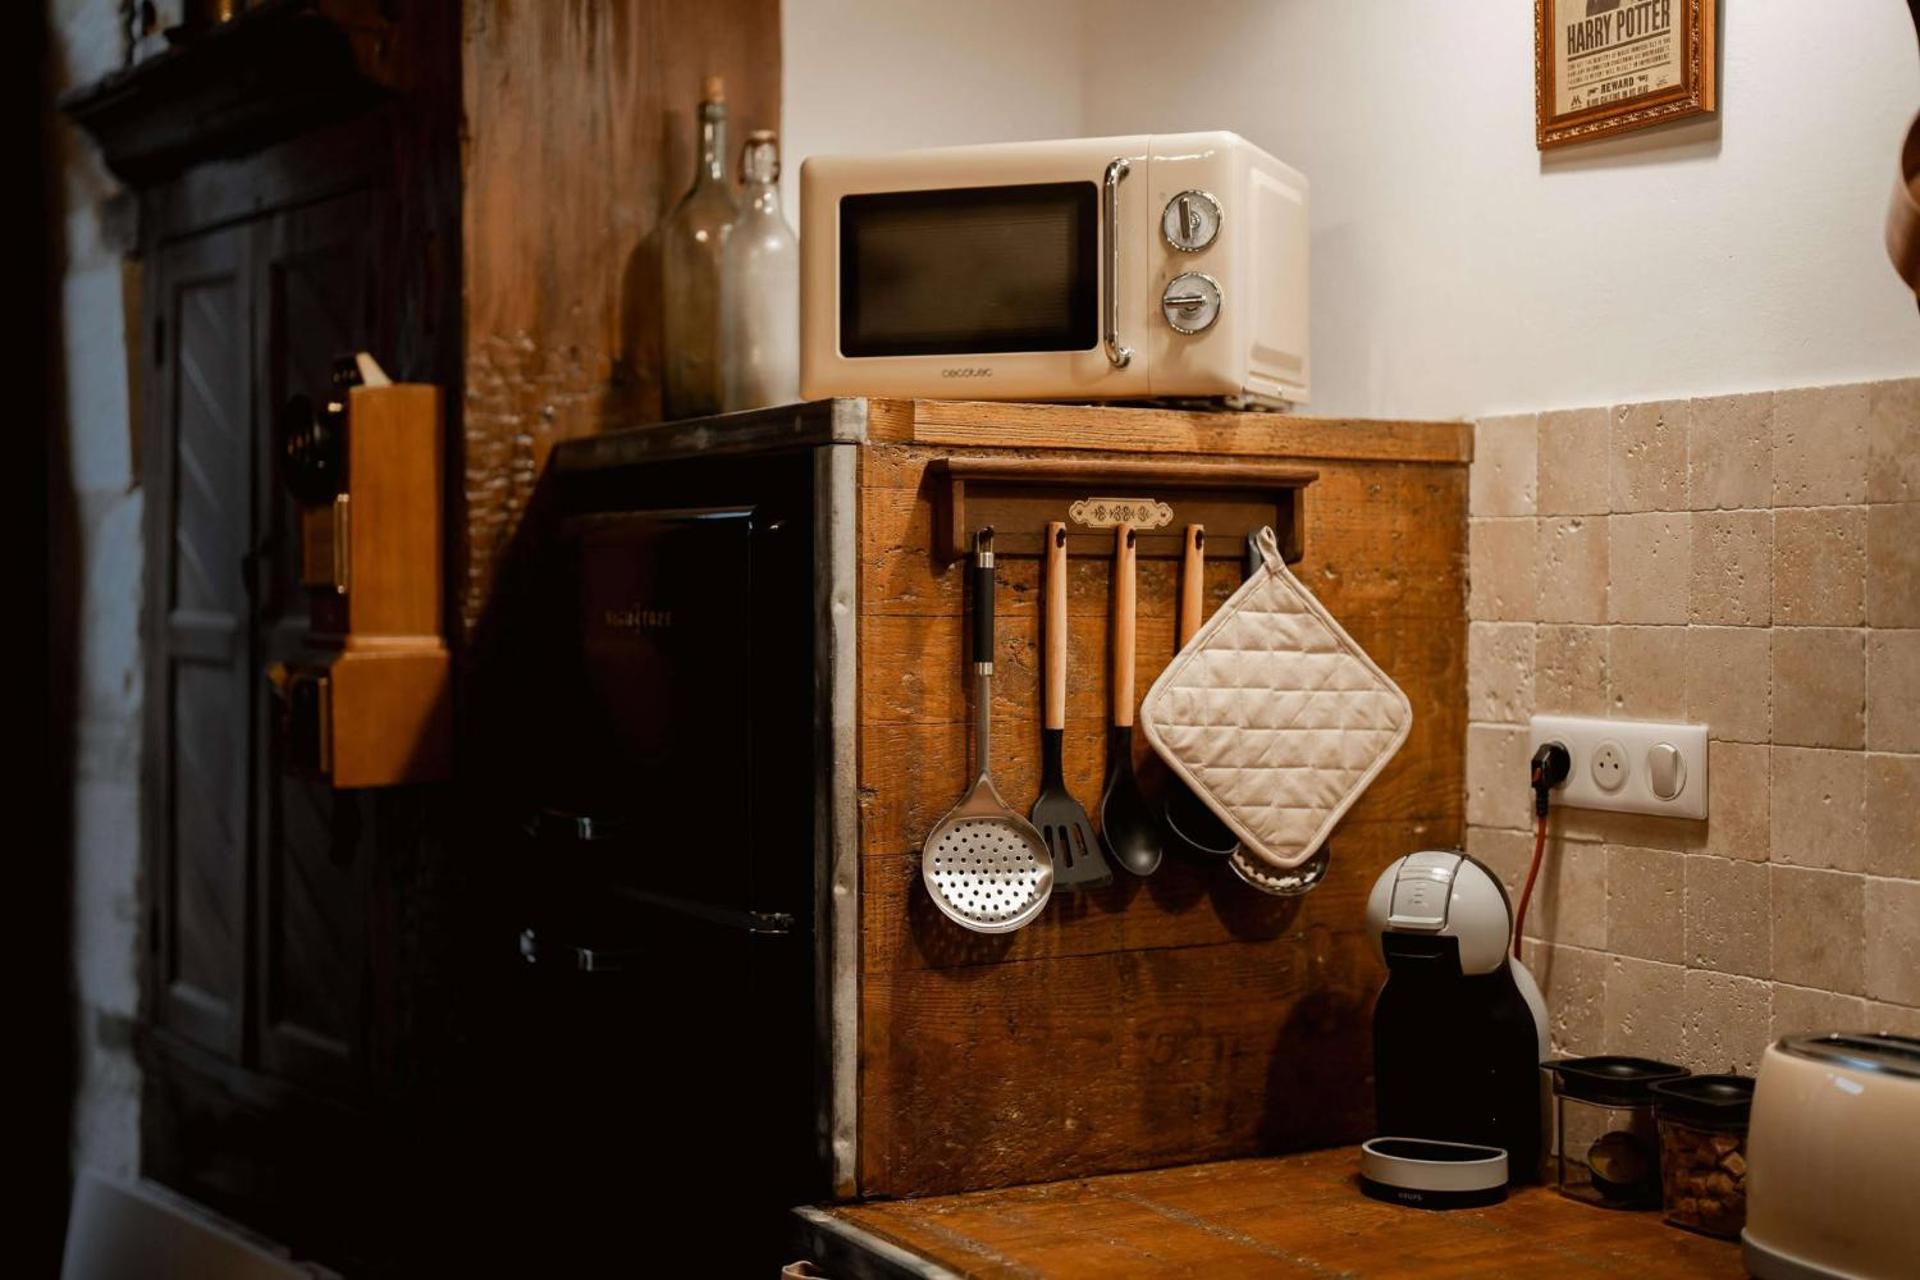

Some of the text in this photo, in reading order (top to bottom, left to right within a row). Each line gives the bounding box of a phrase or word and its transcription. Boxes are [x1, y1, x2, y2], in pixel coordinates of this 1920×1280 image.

[1567, 0, 1670, 55] HARRY POTTER
[1601, 76, 1634, 94] REWARD
